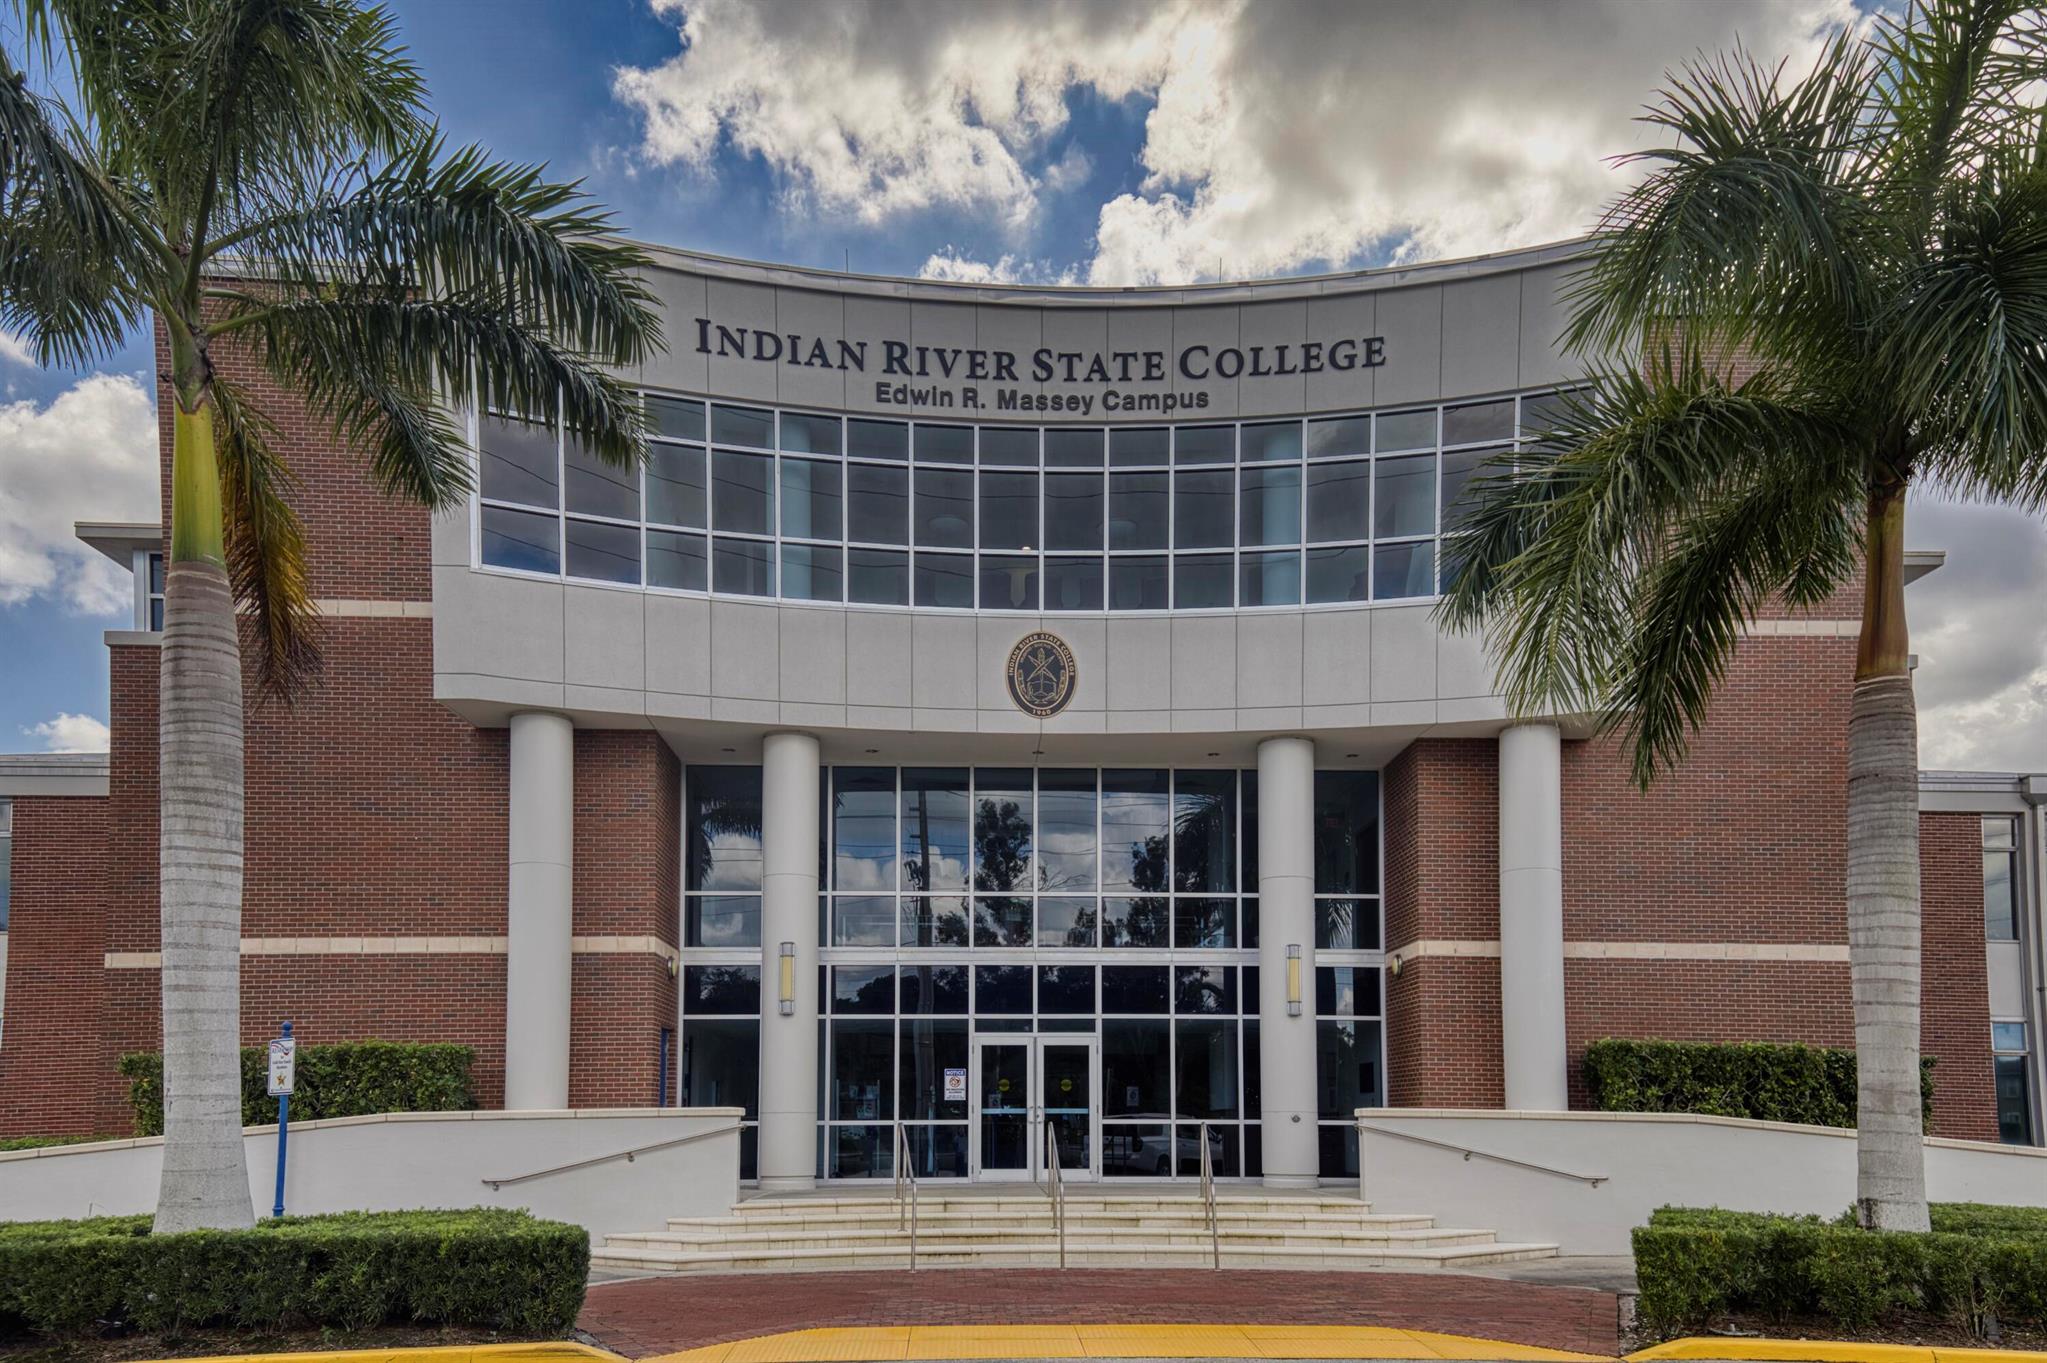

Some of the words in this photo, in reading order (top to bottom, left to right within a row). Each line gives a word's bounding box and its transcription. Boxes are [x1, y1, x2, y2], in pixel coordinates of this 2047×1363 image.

[695, 318, 868, 372] INDIAN
[882, 340, 1019, 382] RIVER
[1032, 348, 1166, 382] STATE
[1179, 336, 1387, 380] COLLEGE
[875, 381, 953, 408] Edwin
[962, 387, 986, 409] R.
[997, 388, 1094, 415] Massey
[1102, 389, 1209, 414] Campus
[1008, 650, 1020, 676] INDIAN
[1019, 634, 1038, 648] RIVER
[1041, 634, 1061, 645] STATE
[1061, 645, 1075, 676] COLLEGE
